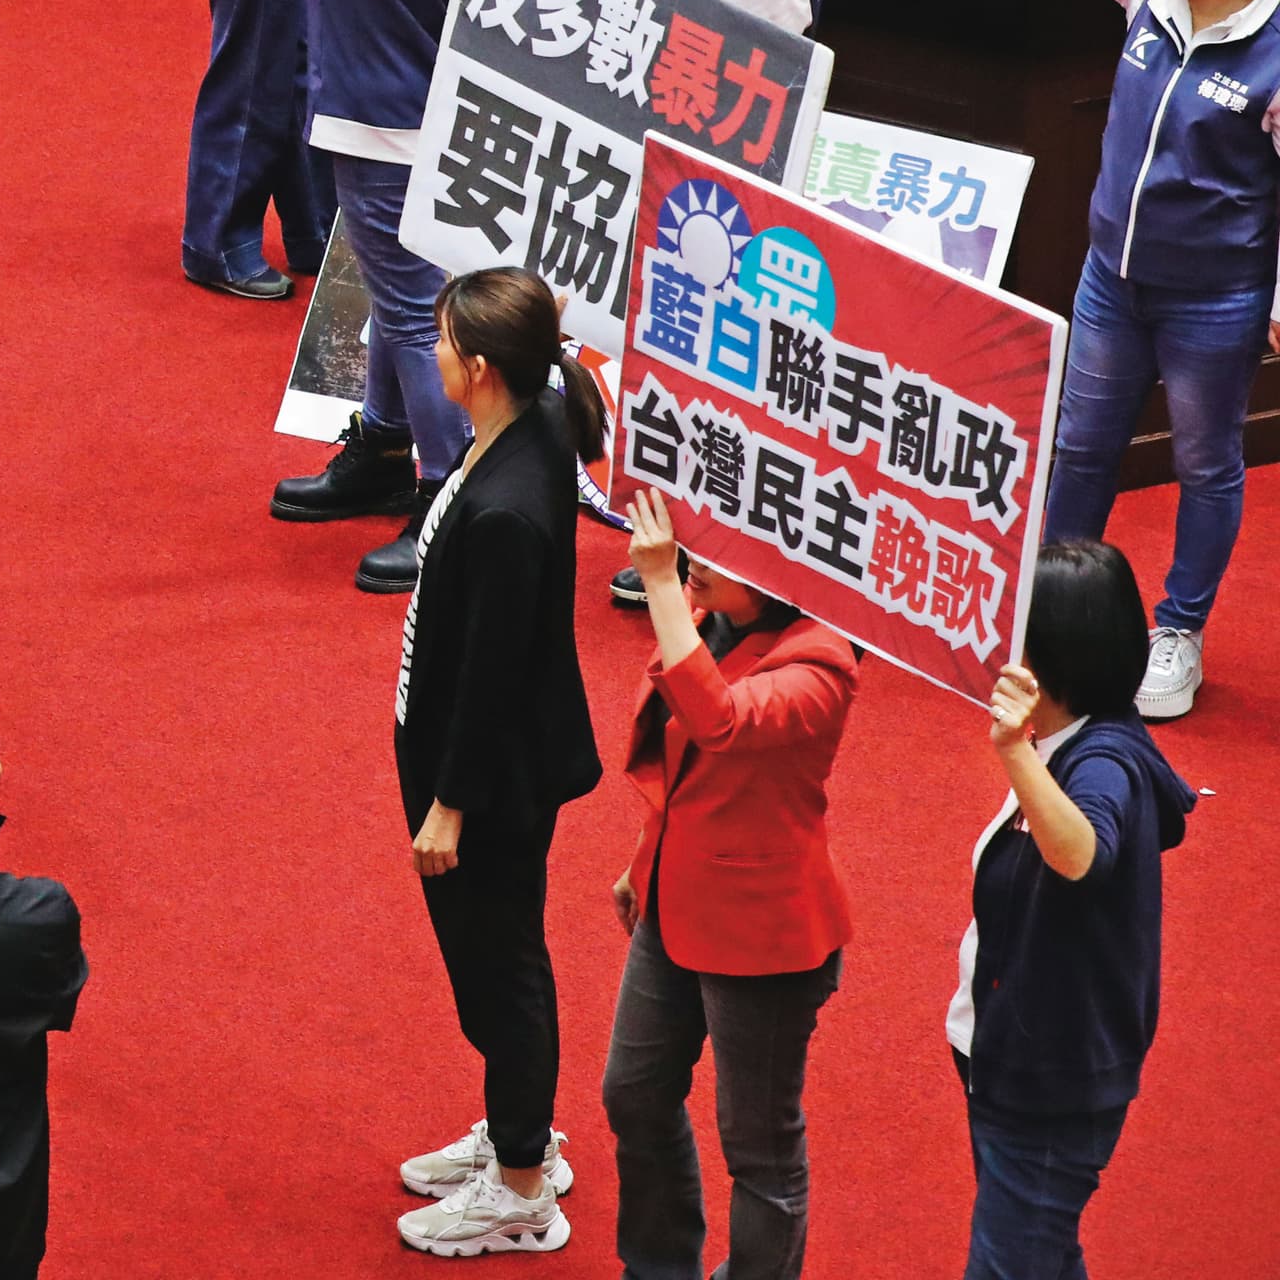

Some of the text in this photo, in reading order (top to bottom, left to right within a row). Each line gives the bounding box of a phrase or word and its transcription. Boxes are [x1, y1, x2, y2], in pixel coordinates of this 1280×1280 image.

[434, 75, 639, 320] 要協
[630, 388, 998, 646] 台灣民主輓歌
[642, 261, 1018, 518] 藍白聯手亂政
